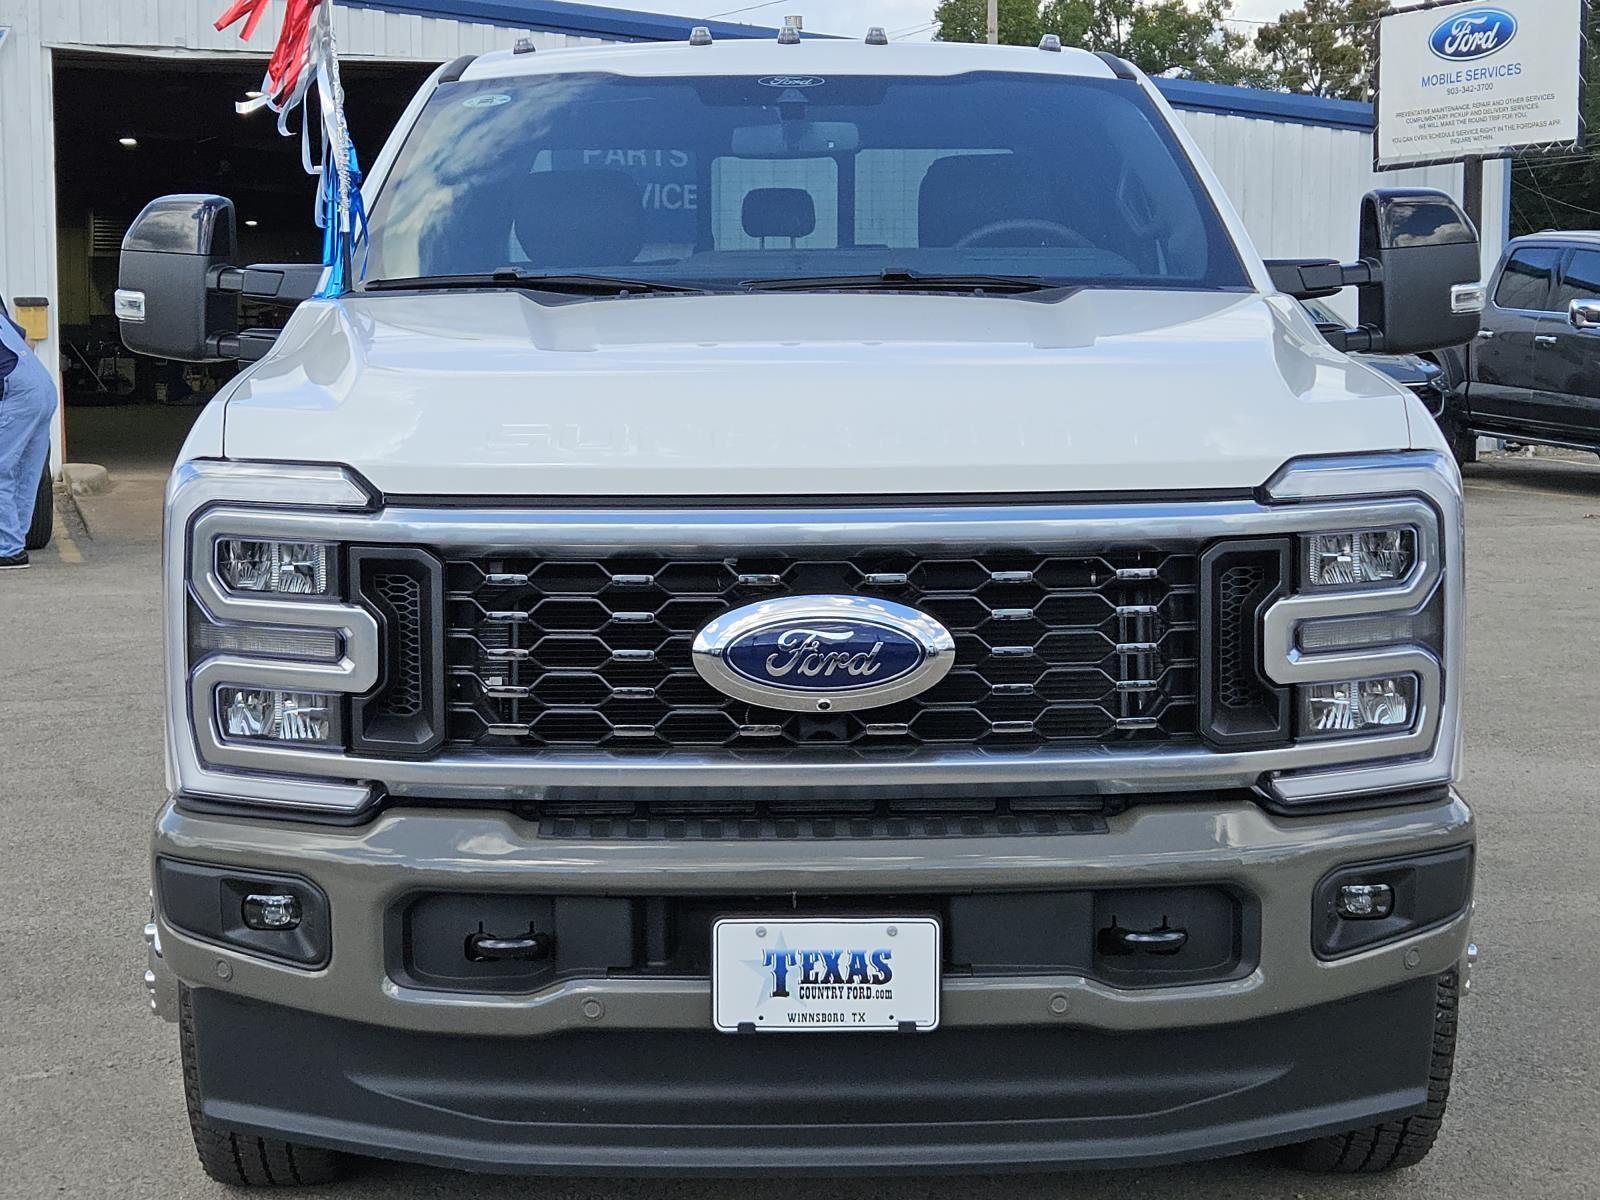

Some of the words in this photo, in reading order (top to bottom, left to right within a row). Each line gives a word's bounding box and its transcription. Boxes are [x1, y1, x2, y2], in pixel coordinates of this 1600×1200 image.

[1444, 16, 1501, 54] Ford
[770, 75, 814, 85] Ford
[1421, 71, 1462, 88] MOBILE
[1464, 63, 1522, 81] SERVICES
[1446, 82, 1494, 96] 903-342-3700
[1505, 96, 1524, 105] OTHER
[1440, 119, 1455, 127] MAKE
[1456, 118, 1467, 126] THE
[1467, 116, 1488, 124] ROUND
[1501, 112, 1513, 120] FOR
[1470, 109, 1482, 117] AND
[1456, 127, 1479, 137] SERVICE
[1479, 126, 1497, 134] RIGHT
[1504, 123, 1516, 131] THE
[766, 628, 884, 677] Ford
[762, 948, 893, 998] TEXAS
[799, 986, 844, 1000] COUNTRY
[846, 986, 893, 1000] FORD.com
[852, 1012, 866, 1023] TX
